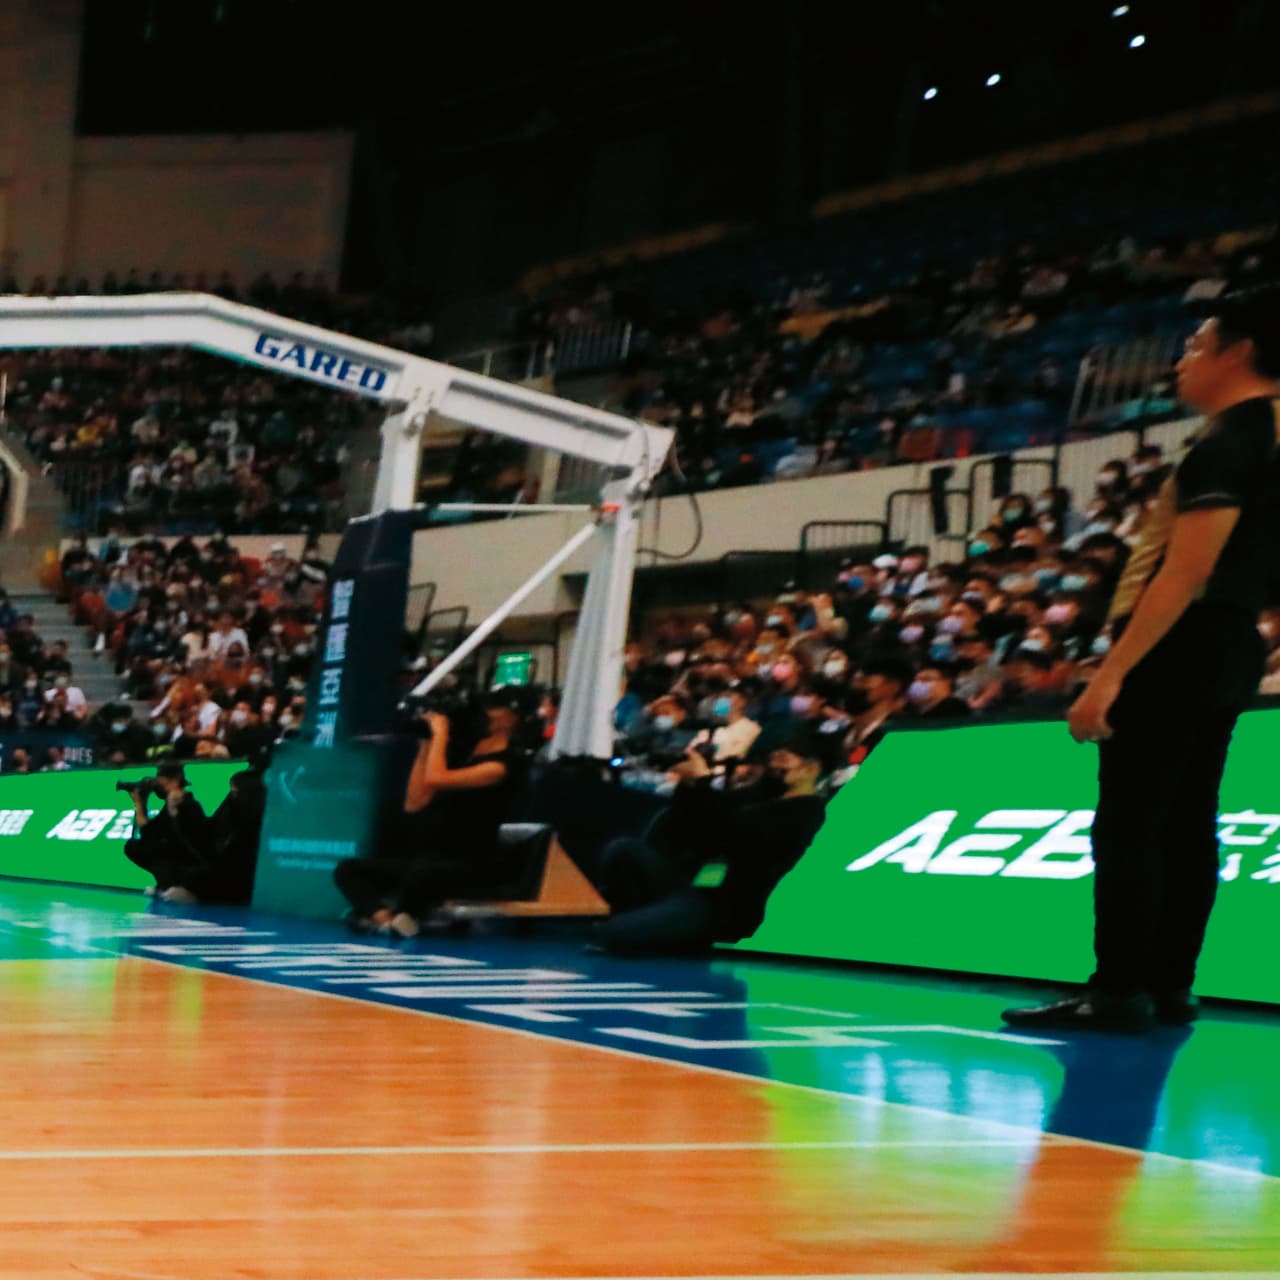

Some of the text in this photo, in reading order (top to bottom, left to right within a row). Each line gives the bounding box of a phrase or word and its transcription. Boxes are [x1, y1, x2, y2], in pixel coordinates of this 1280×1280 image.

[255, 333, 387, 391] GARED
[46, 809, 117, 840] AEB
[846, 810, 1097, 880] AEB
